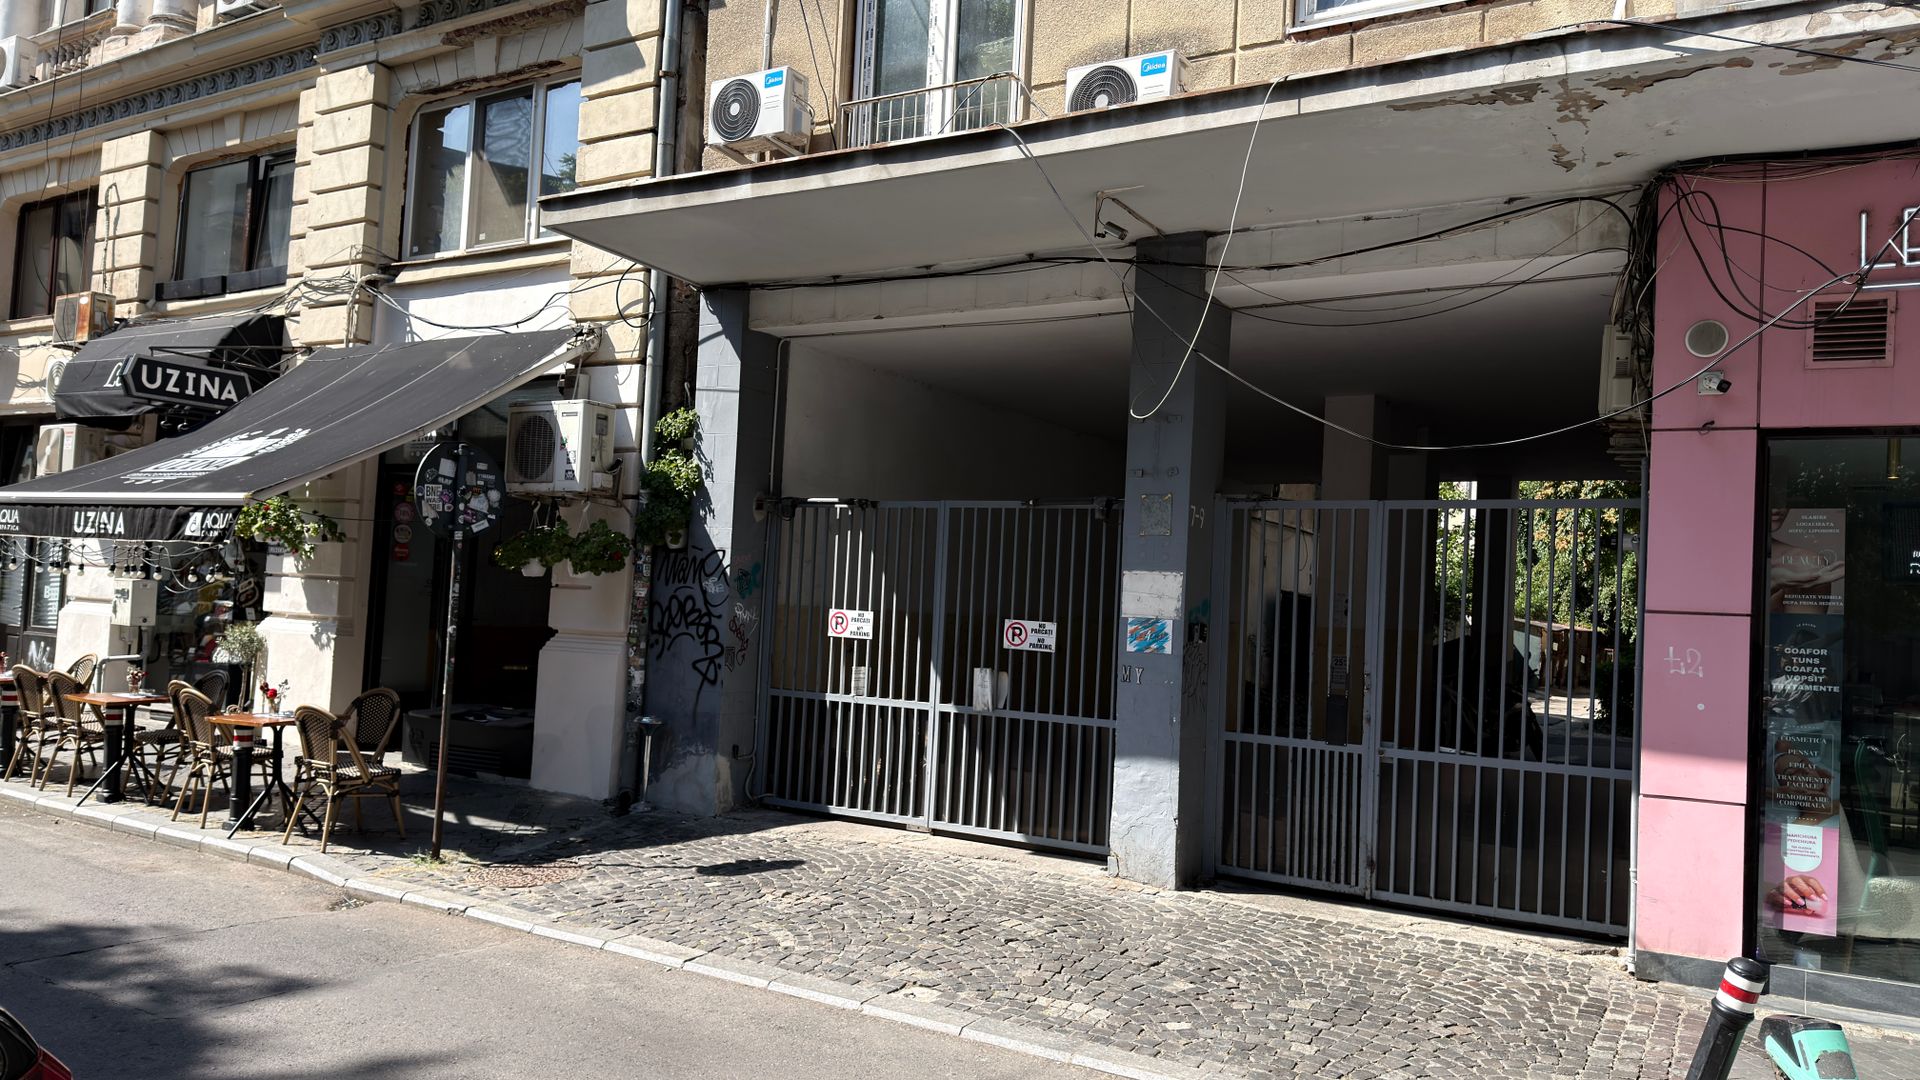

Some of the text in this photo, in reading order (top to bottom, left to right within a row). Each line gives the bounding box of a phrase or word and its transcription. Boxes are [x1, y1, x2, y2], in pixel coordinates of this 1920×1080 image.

[141, 363, 239, 403] UZINA
[73, 511, 125, 535] UZINA
[1030, 628, 1053, 636] PARCATI
[1784, 647, 1828, 656] COAFOR
[1791, 656, 1820, 664] TUNS
[1784, 665, 1827, 674] COAFAT
[1786, 674, 1825, 682] VOPSIT
[1772, 683, 1840, 693] TRATAMENTE
[1780, 735, 1827, 744] COSMETICA
[1788, 748, 1819, 756] PENSAT
[1789, 761, 1817, 770] EPILAT
[1776, 774, 1831, 784] TRATAMENTE
[1786, 781, 1819, 789] FACIALE
[1776, 793, 1830, 803] REMODELARE
[1779, 800, 1826, 809] CORPORALA
